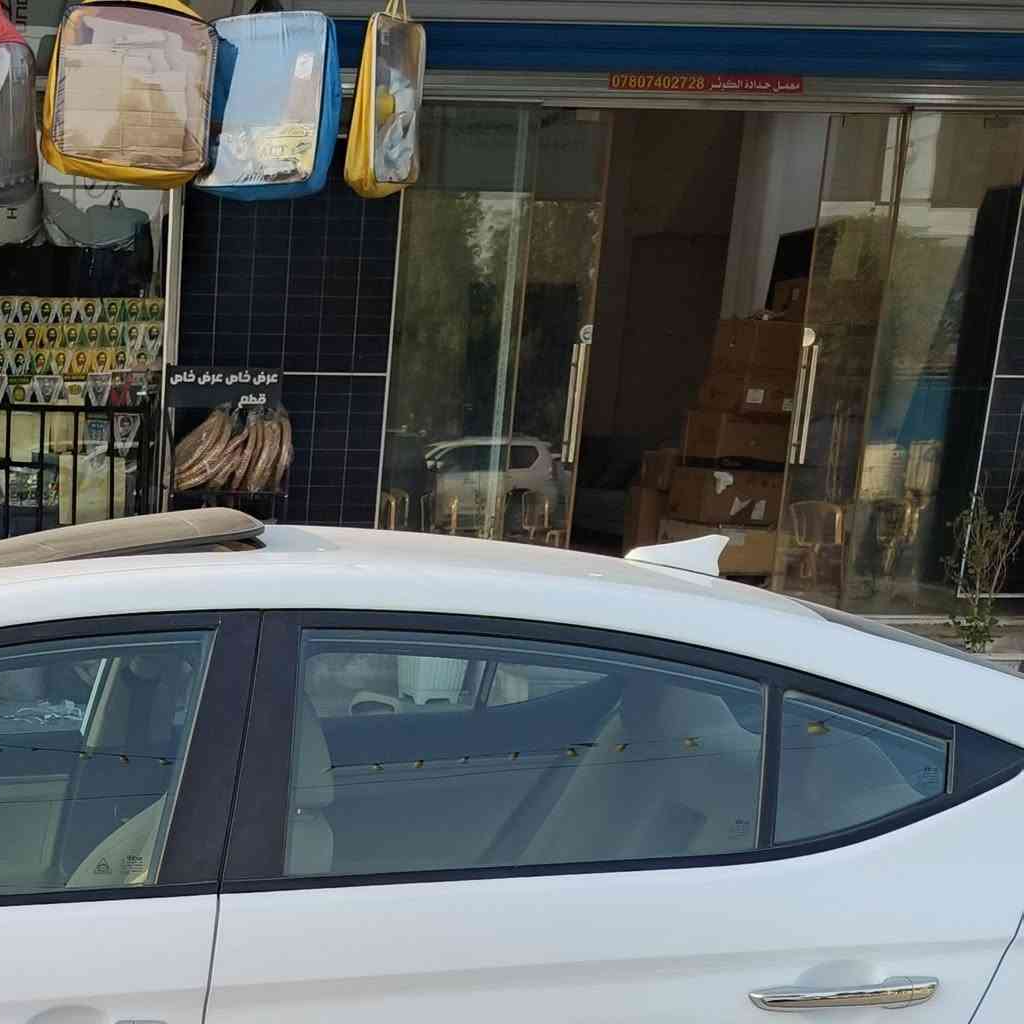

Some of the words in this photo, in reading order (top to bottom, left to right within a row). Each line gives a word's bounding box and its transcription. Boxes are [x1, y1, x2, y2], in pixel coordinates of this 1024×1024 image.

[611, 74, 705, 90] 07807402728
[170, 369, 196, 385] خاص
[198, 371, 224, 385] عرض
[225, 370, 251, 386] خاص
[253, 371, 279, 385] عرض
